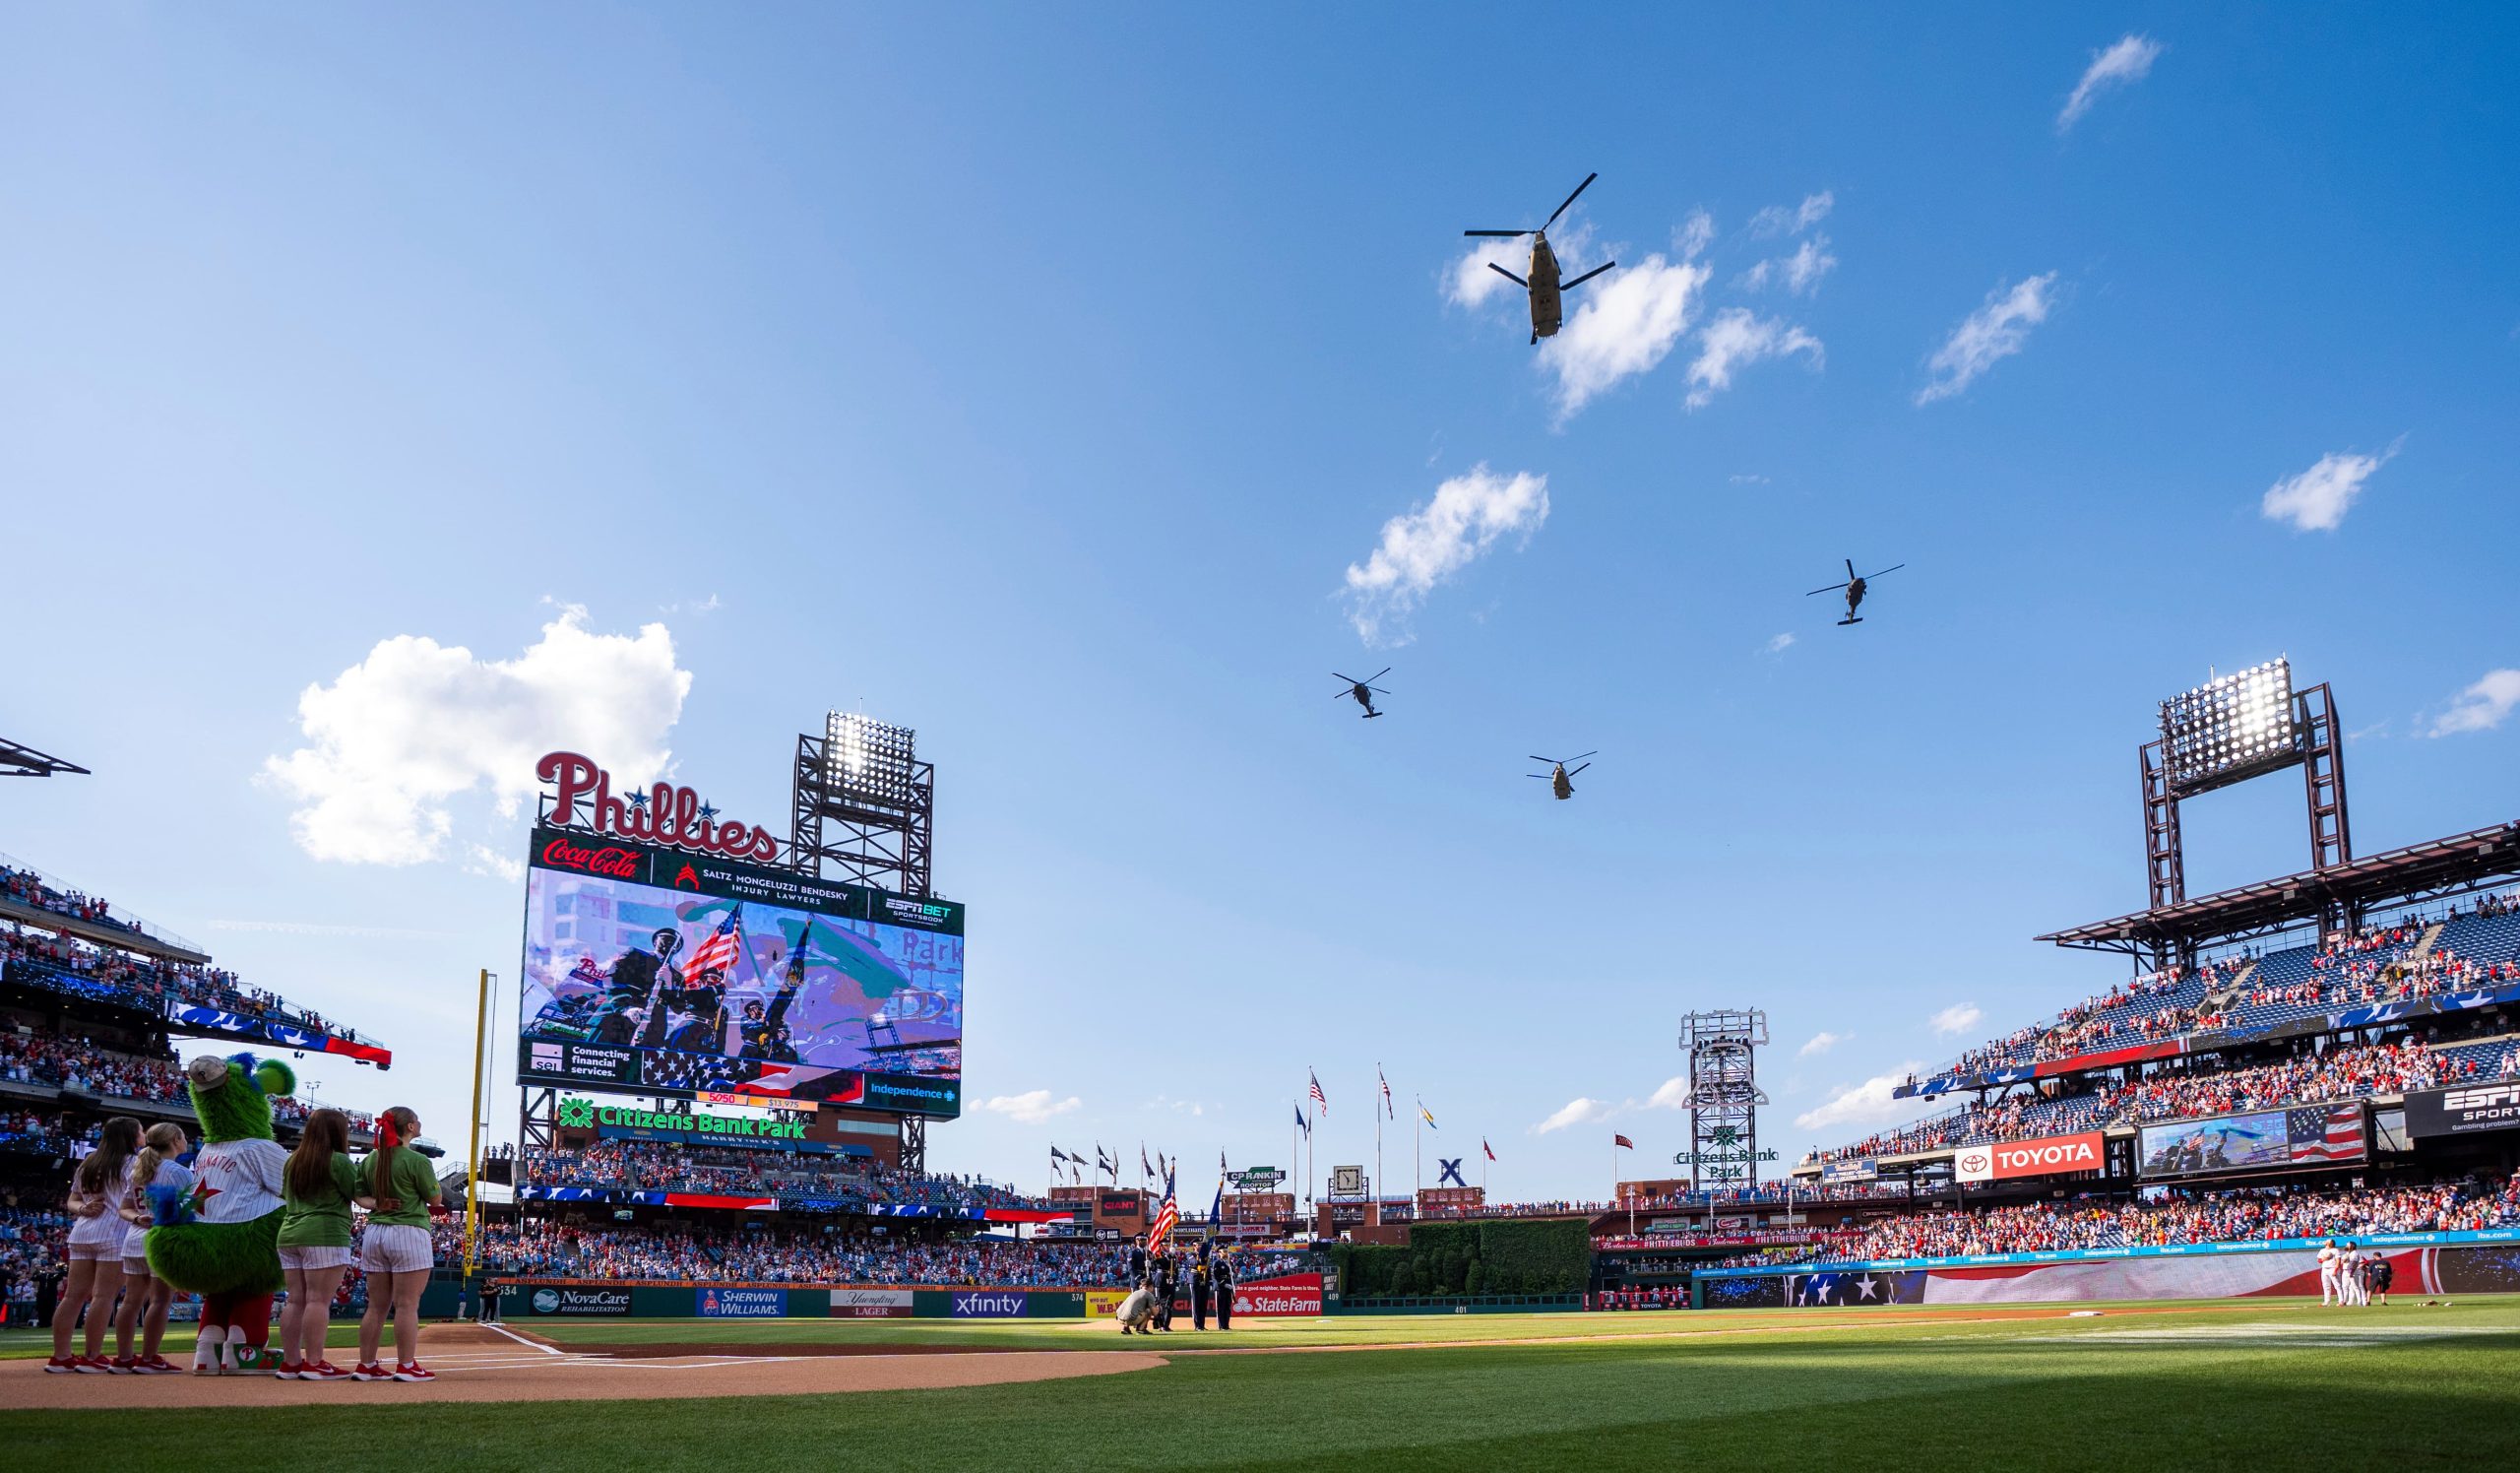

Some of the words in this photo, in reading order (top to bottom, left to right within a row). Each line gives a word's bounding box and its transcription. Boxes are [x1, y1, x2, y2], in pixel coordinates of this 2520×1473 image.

[536, 751, 779, 863] Phillies
[542, 838, 641, 878] Coca-Cola
[703, 868, 731, 881] SALTZ
[735, 874, 797, 892] MONGELUZZI
[800, 885, 849, 901] BENDESKY
[731, 884, 769, 897] INJURY
[777, 892, 821, 905] LAWYERS
[893, 910, 944, 924] SPORTSBOOK
[572, 1046, 630, 1061] Connecting
[572, 1056, 616, 1068] financial
[571, 1066, 616, 1077] services.
[871, 1083, 942, 1099] Independence
[768, 1099, 799, 1109] $13,975
[598, 1105, 694, 1131] Citizens
[698, 1112, 755, 1135] Bank
[758, 1118, 806, 1139] Park
[2452, 1122, 2485, 1131] Gambling
[2486, 1119, 2520, 1129] problem?
[702, 1134, 742, 1143] HARRY
[1675, 1151, 1735, 1164] Citizens
[1738, 1148, 1777, 1162] Bank
[1997, 1142, 2094, 1170] TOYOTA
[1245, 1171, 1282, 1180] RANKIN
[1710, 1165, 1742, 1178] Park
[1103, 1201, 1135, 1210] GIANT
[1755, 1234, 1811, 1244] #HITTHEBUDS
[2371, 1234, 2426, 1244] Independence
[2478, 1231, 2512, 1241] ibx.com
[1644, 1239, 1696, 1248] #HITTHEBUDS
[2216, 1242, 2262, 1250] Independence
[2084, 1249, 2122, 1257] Independence
[560, 1290, 629, 1305] NovaCare
[723, 1290, 778, 1303] SHERWIN
[845, 1291, 899, 1306] Yuengling
[1071, 1293, 1083, 1302] 374
[721, 1303, 780, 1314] WILLIAMS
[957, 1293, 1023, 1314] xfinity
[854, 1307, 889, 1315] LAGER
[1455, 1306, 1467, 1314] 401
